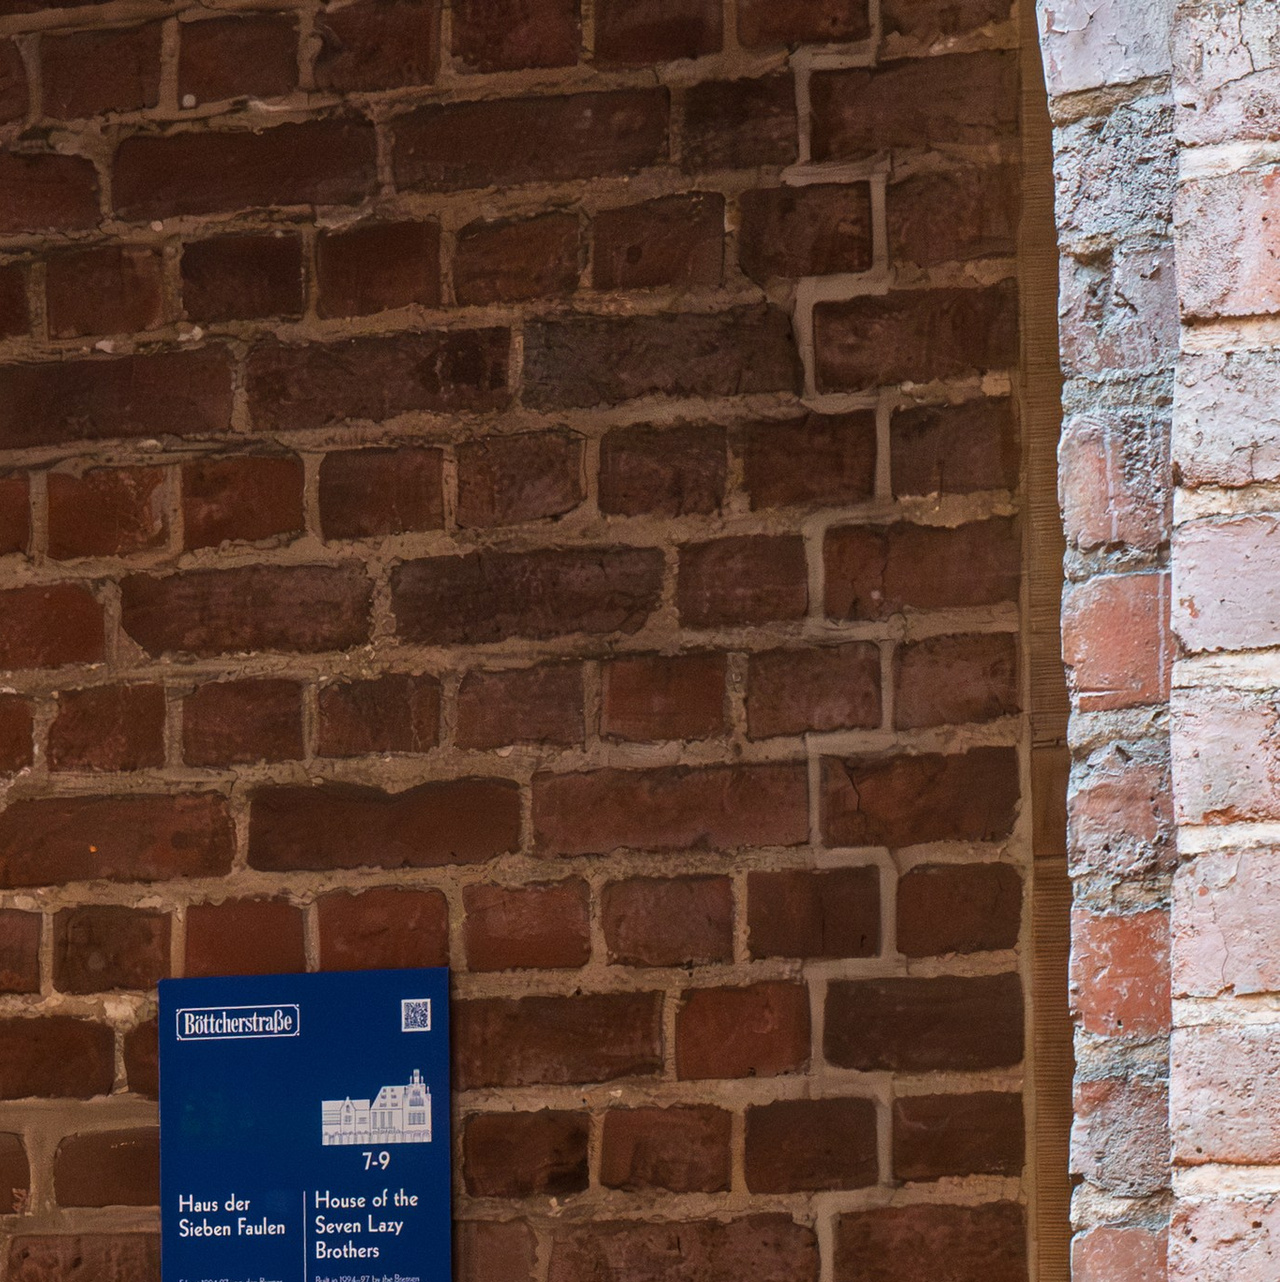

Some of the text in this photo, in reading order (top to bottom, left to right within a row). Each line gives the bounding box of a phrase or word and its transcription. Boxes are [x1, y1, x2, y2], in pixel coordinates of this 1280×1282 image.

[184, 1010, 292, 1034] Böttcherstraße
[362, 1151, 390, 1170] 7-9
[179, 1193, 250, 1212] Haus der
[316, 1188, 418, 1208] House of the
[180, 1218, 285, 1237] Sieben Faulen
[316, 1215, 403, 1235] Seven Lazy
[316, 1241, 379, 1258] Brothers
[382, 1274, 393, 1282] the
[394, 1273, 420, 1282] Bremen
